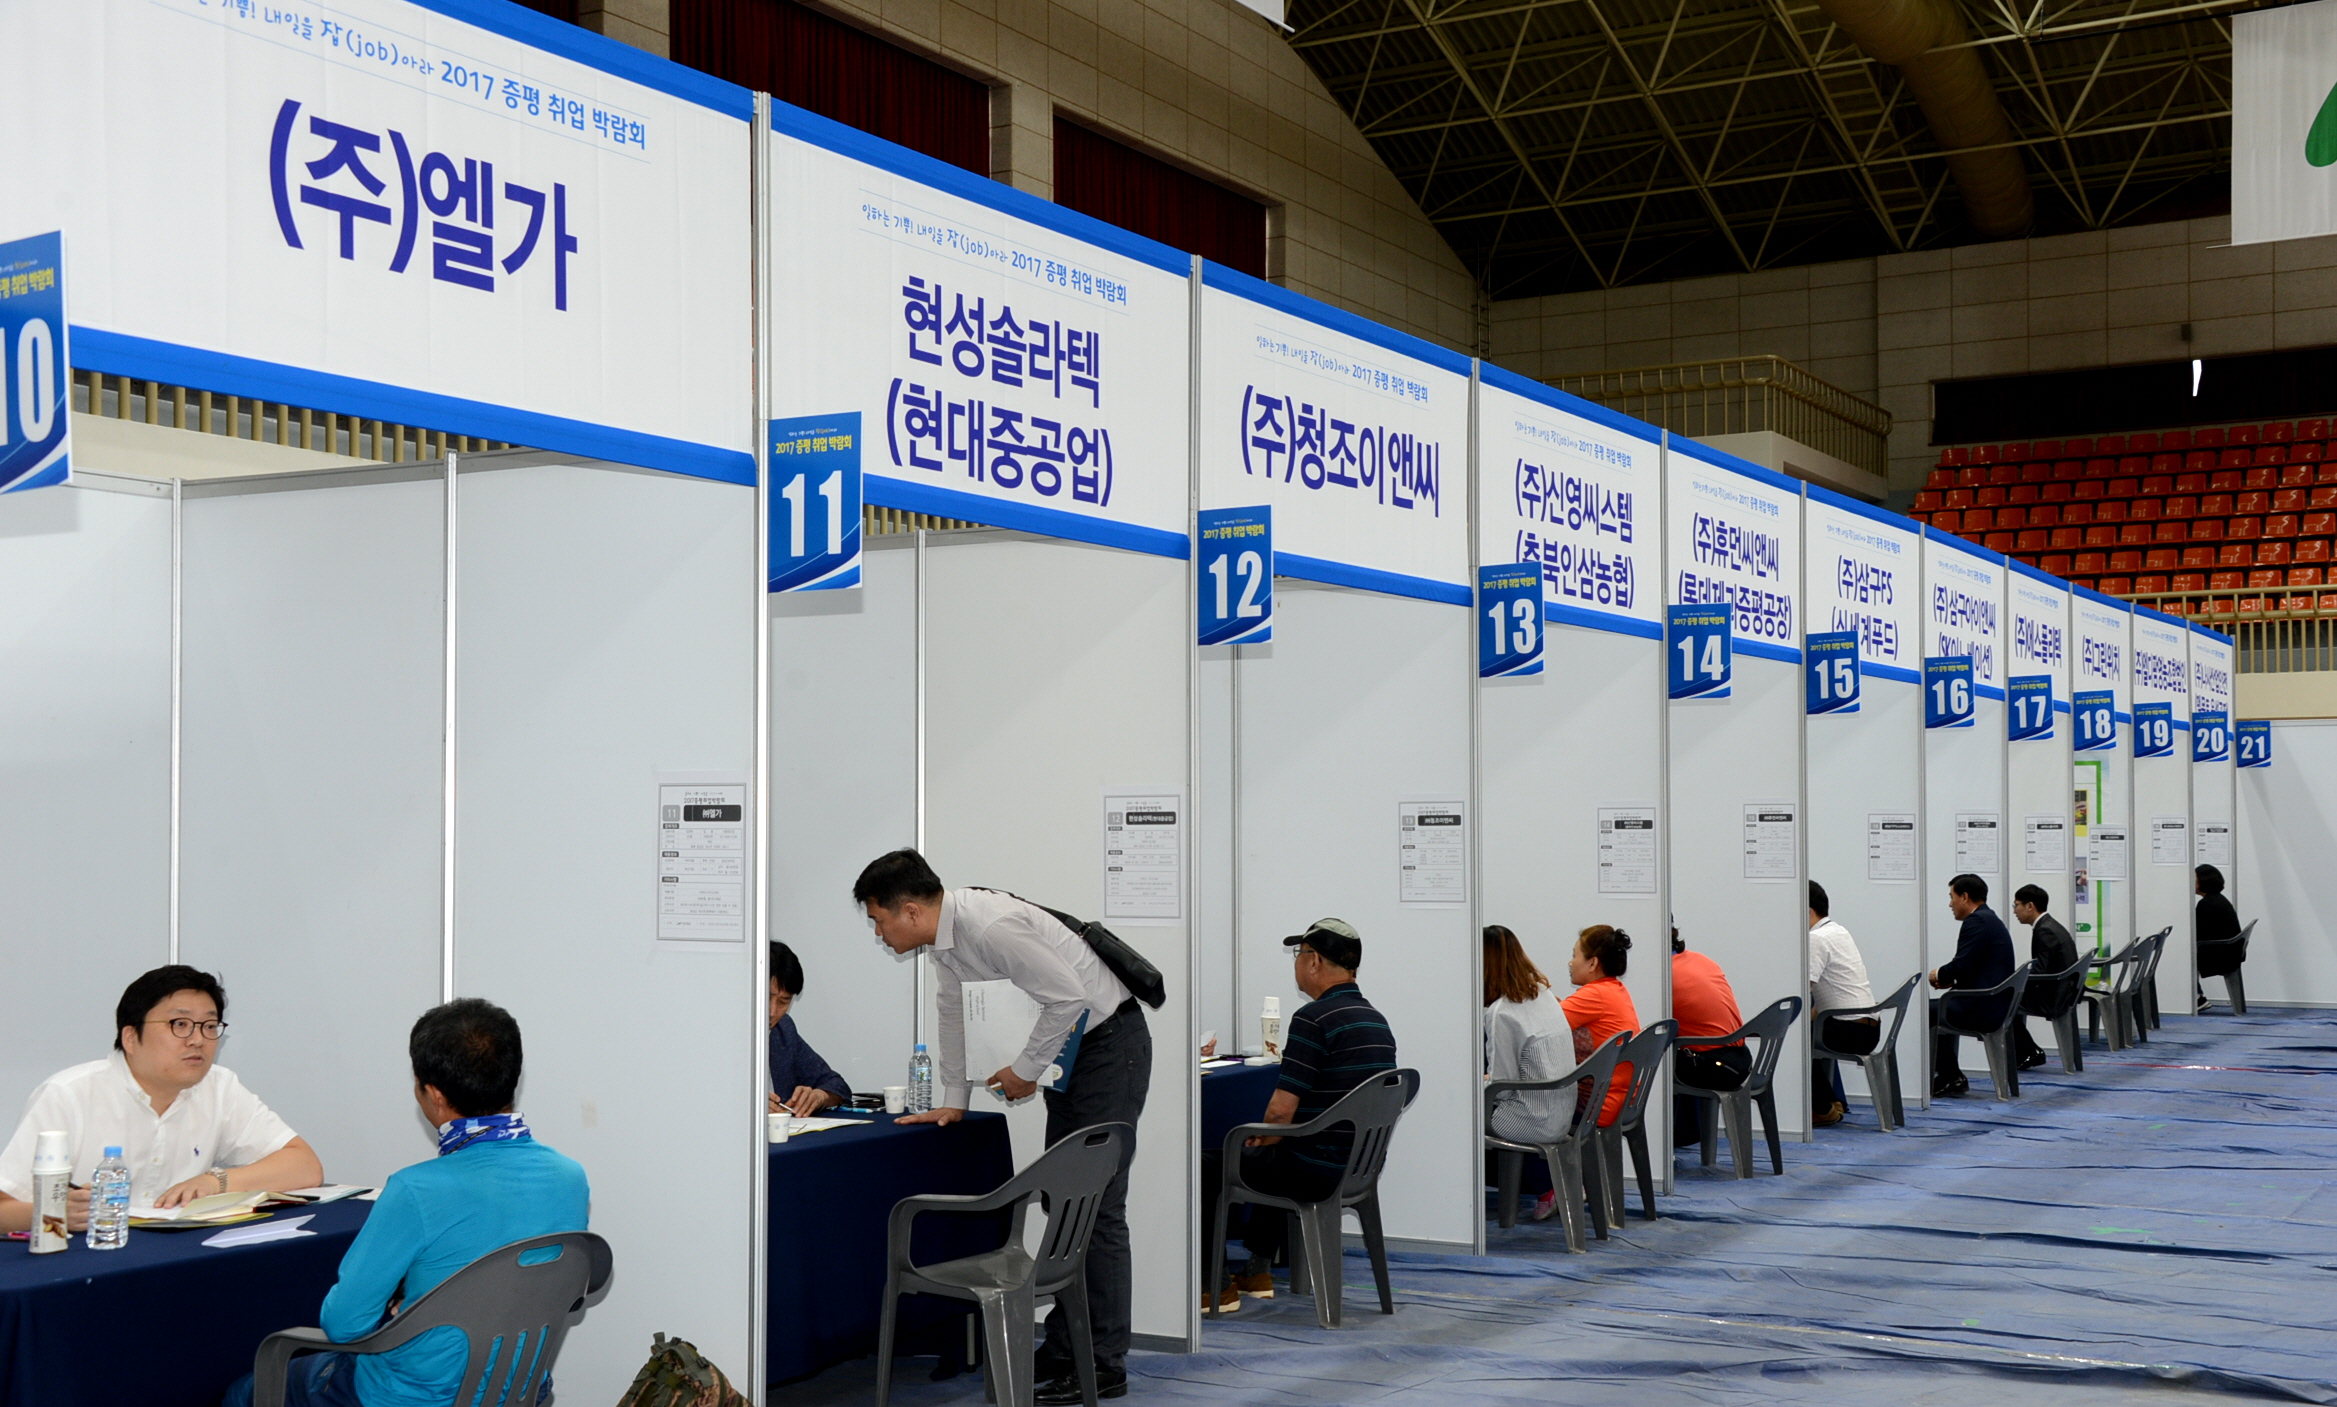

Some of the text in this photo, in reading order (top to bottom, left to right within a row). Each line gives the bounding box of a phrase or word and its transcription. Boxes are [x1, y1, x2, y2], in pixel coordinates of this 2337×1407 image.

[264, 7, 313, 41] 내일을
[320, 19, 435, 75] 잡(job)아라
[441, 61, 495, 100] 2017
[501, 78, 540, 117] 증평
[548, 94, 585, 131] 취업
[592, 108, 646, 150] 박람회
[269, 98, 578, 312] (주)엘가
[862, 204, 1127, 306] 일하는 기쁨! 내일을 잡(job)아라 2017 증평 취업 박람회
[902, 275, 1099, 409] 현성솔라텍
[1352, 364, 1372, 385] 2017
[1374, 370, 1389, 391] 증평
[1391, 375, 1405, 396] 취업
[1407, 380, 1428, 403] 박람회
[775, 434, 852, 456] 2017 증평 취업 박람회
[886, 377, 1113, 508] (현대중공업)
[1241, 384, 1439, 518] (주)청조이앤씨
[1579, 440, 1593, 456] 2017
[782, 470, 842, 557] 11
[1515, 458, 1632, 544] (주)신영씨스템
[1693, 512, 1779, 582] (주)휴먼씨앤씨
[1209, 550, 1263, 620] 12
[1837, 554, 1893, 606] (주)삼구FS
[1488, 598, 1537, 655] 13
[1677, 634, 1724, 681] 14
[1814, 657, 1854, 700] 15
[1931, 678, 1969, 715] 16
[2014, 695, 2047, 729] 17
[2079, 709, 2111, 740] 18
[2139, 719, 2169, 747] 19
[2196, 727, 2224, 753] 20
[2240, 735, 2265, 759] 21
